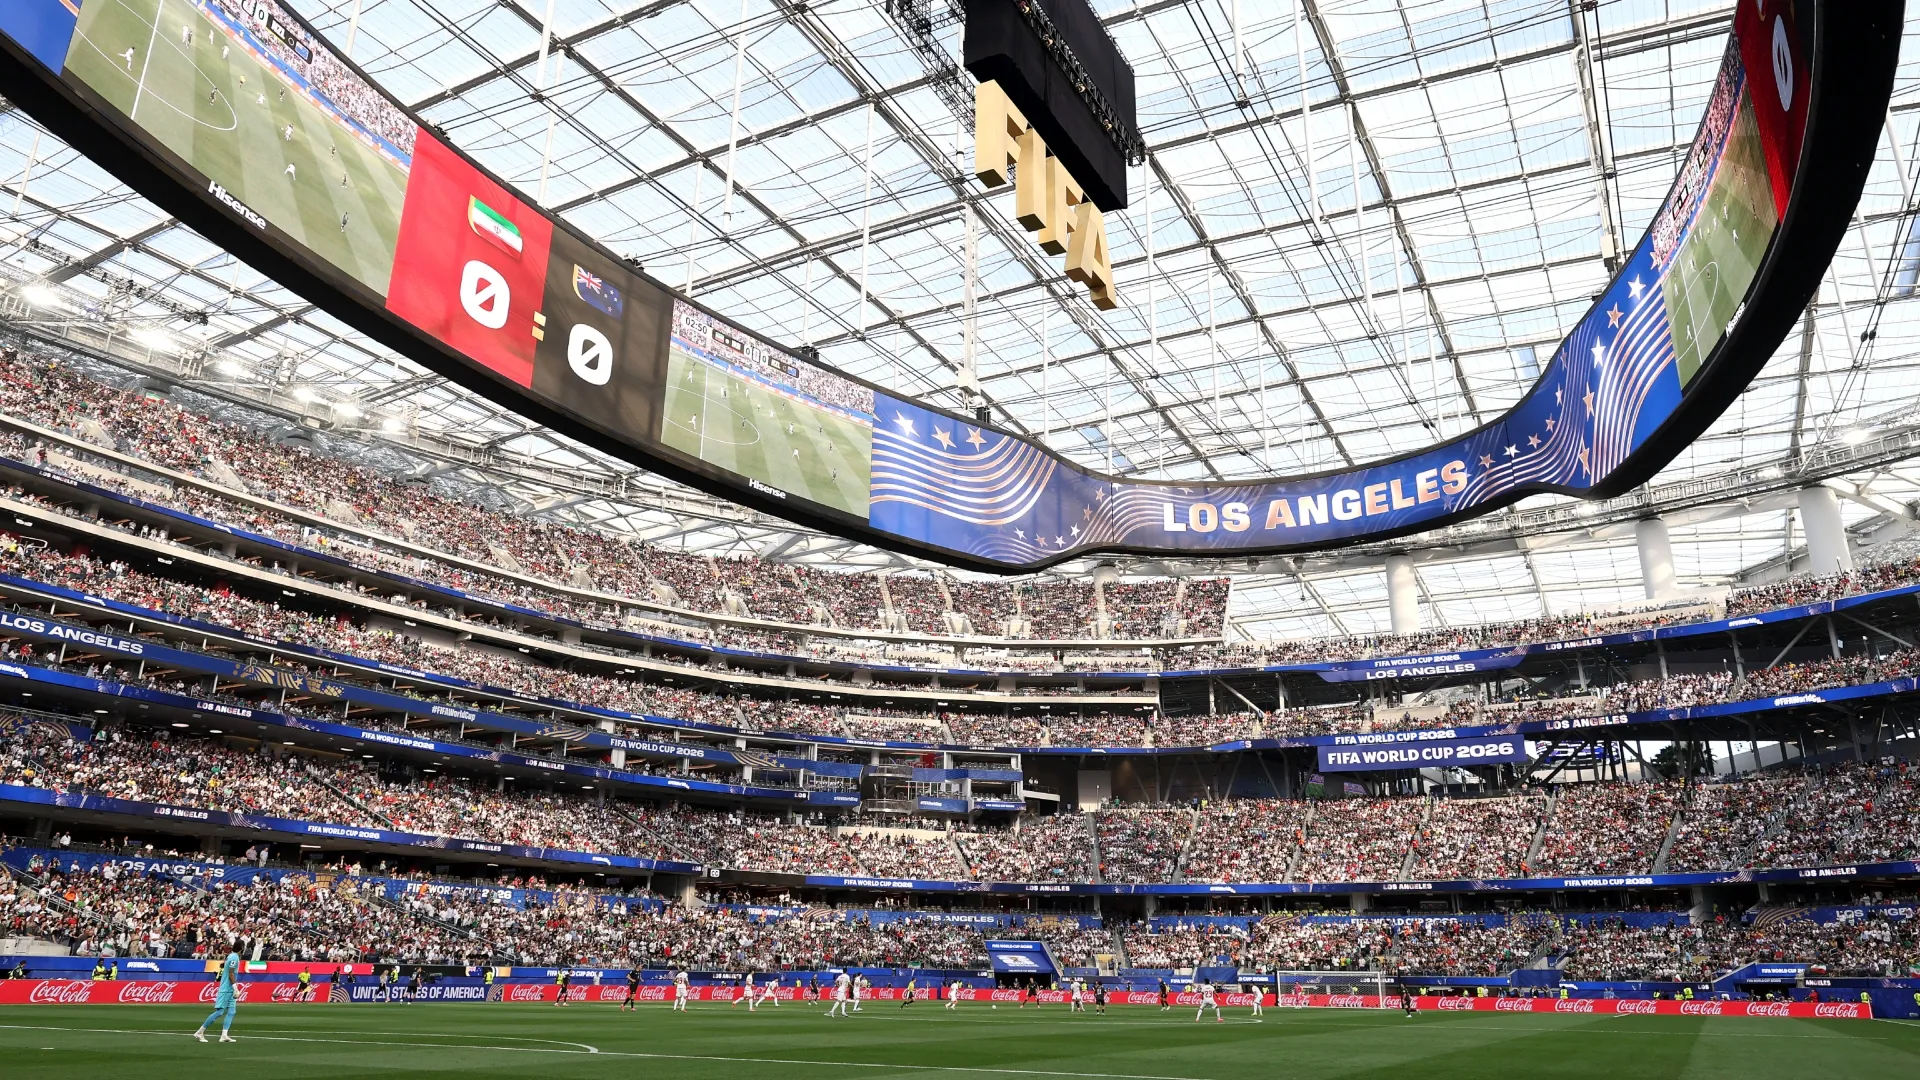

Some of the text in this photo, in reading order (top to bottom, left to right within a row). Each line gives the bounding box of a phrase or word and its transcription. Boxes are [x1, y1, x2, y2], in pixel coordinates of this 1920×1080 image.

[1772, 14, 1793, 111] 0
[975, 79, 1118, 311] FIFA
[208, 180, 266, 230] Hisense
[460, 260, 613, 385] 0 0
[685, 316, 708, 334] 02:50
[748, 478, 786, 499] Hisense
[1162, 459, 1469, 533] LOS ANGELES
[0, 614, 144, 655] LOS ANGELES
[1564, 638, 1603, 649] ANGELES
[1392, 658, 1417, 666] WORLD
[1434, 654, 1460, 662] 2026
[1366, 664, 1476, 680] LOS ANGELES
[197, 702, 252, 718] LOS ANGELES
[432, 706, 476, 722] #FIFAWorldCup
[1546, 715, 1628, 730] LOS ANGELES
[362, 732, 376, 740] FIFA
[376, 734, 400, 744] WORLD
[1335, 729, 1456, 745] FIFA WORLD CUP 2026
[610, 738, 705, 758] FIFA WORLD CUP 2026
[1328, 742, 1514, 764] FIFA WORLD CUP 2026
[538, 762, 565, 770] ANGELES
[171, 808, 208, 820] ANGELES
[322, 827, 345, 836] WORLD
[1818, 867, 1857, 876] ANGELES
[406, 882, 422, 893] FIF
[482, 888, 512, 900] 226
[30, 980, 96, 1002] Coca-Cola
[118, 981, 178, 1002] Coca-Cola
[429, 987, 441, 999] OF
[443, 987, 484, 999] AMERICA
[1495, 998, 1534, 1012] Coca-Cola
[1554, 998, 1595, 1013] Coca-Cola
[1616, 1000, 1658, 1014] Coca-Cola
[1680, 1000, 1723, 1016] Coca-Cola
[1746, 1001, 1790, 1017] Coca-Cola
[1814, 1002, 1859, 1018] Coca-Cola
